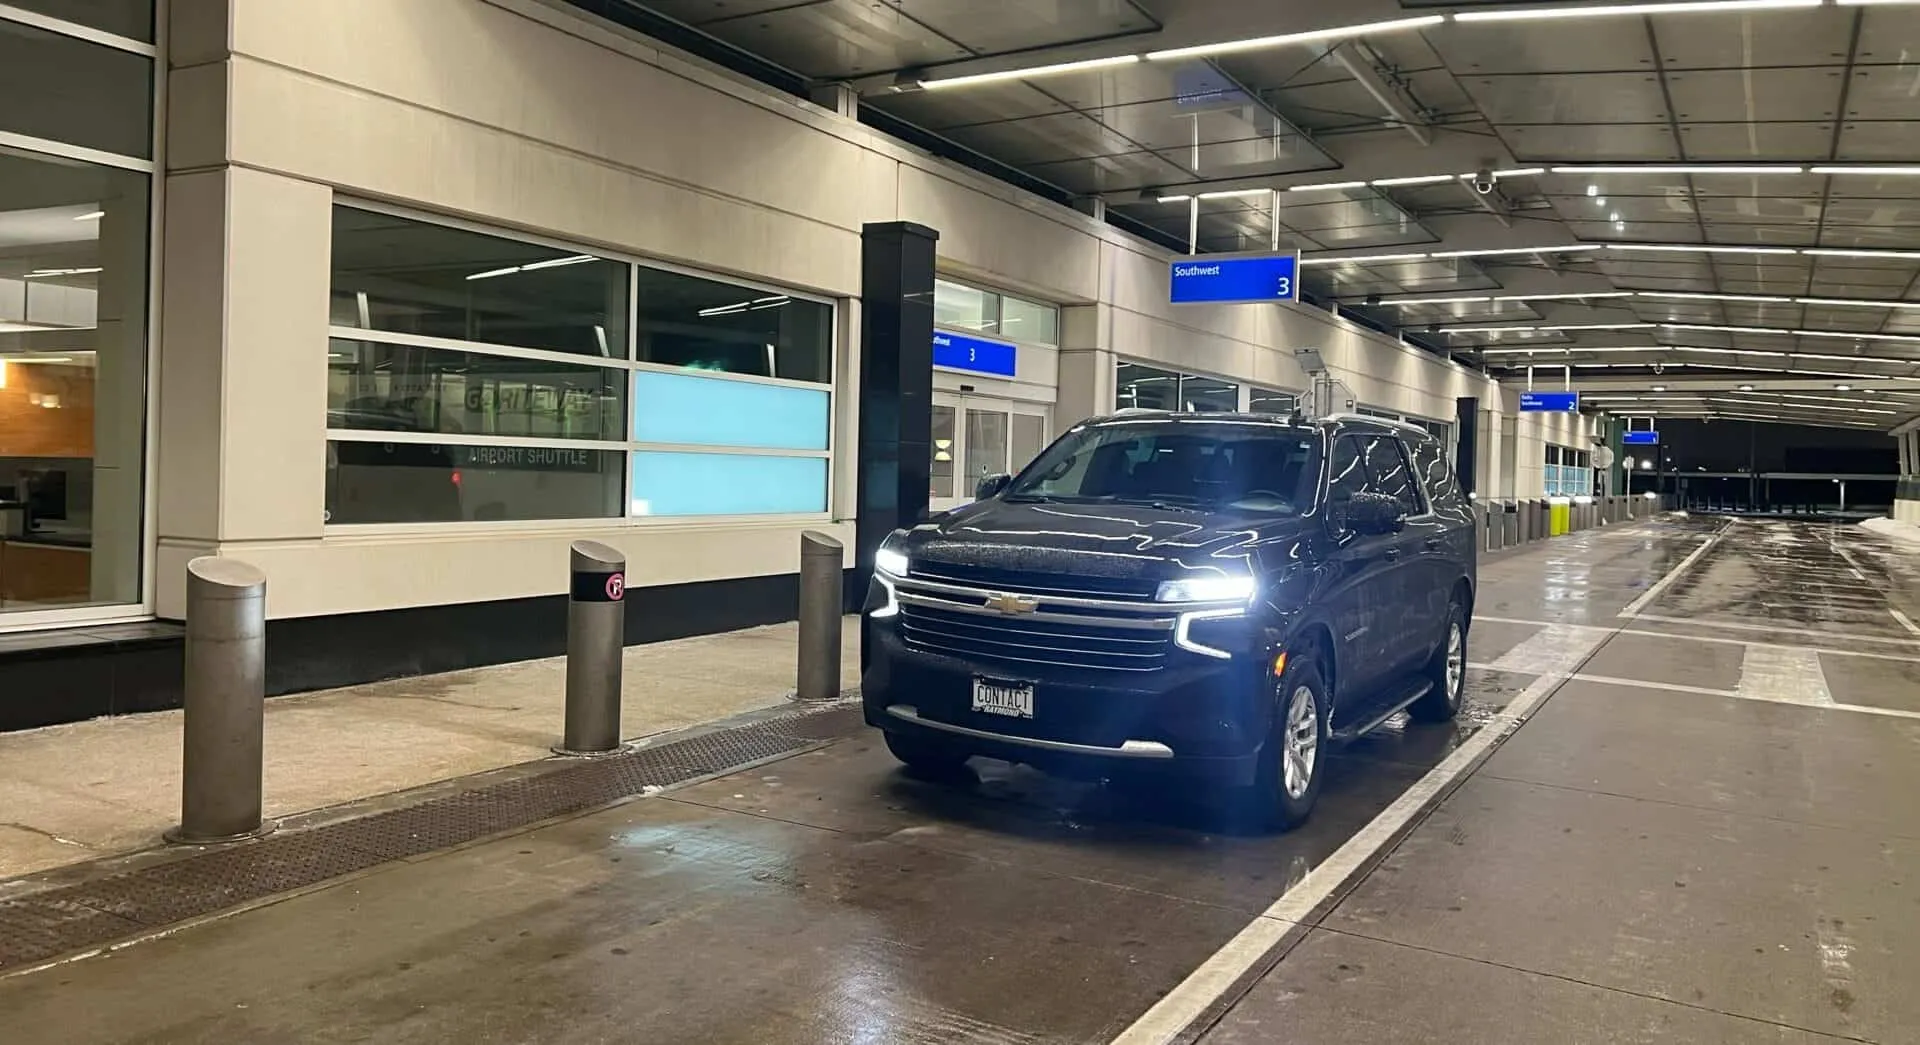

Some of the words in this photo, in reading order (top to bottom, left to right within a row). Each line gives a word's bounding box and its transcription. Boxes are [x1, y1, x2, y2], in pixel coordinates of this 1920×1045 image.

[1175, 265, 1220, 277] Southwest
[1277, 277, 1290, 295] 3
[969, 347, 976, 362] 3
[1568, 401, 1575, 410] 2
[468, 447, 525, 464] AIRPORT
[527, 449, 588, 465] SHUTTLE
[977, 686, 1029, 710] CONTACT
[984, 704, 1020, 718] RAYMOND
